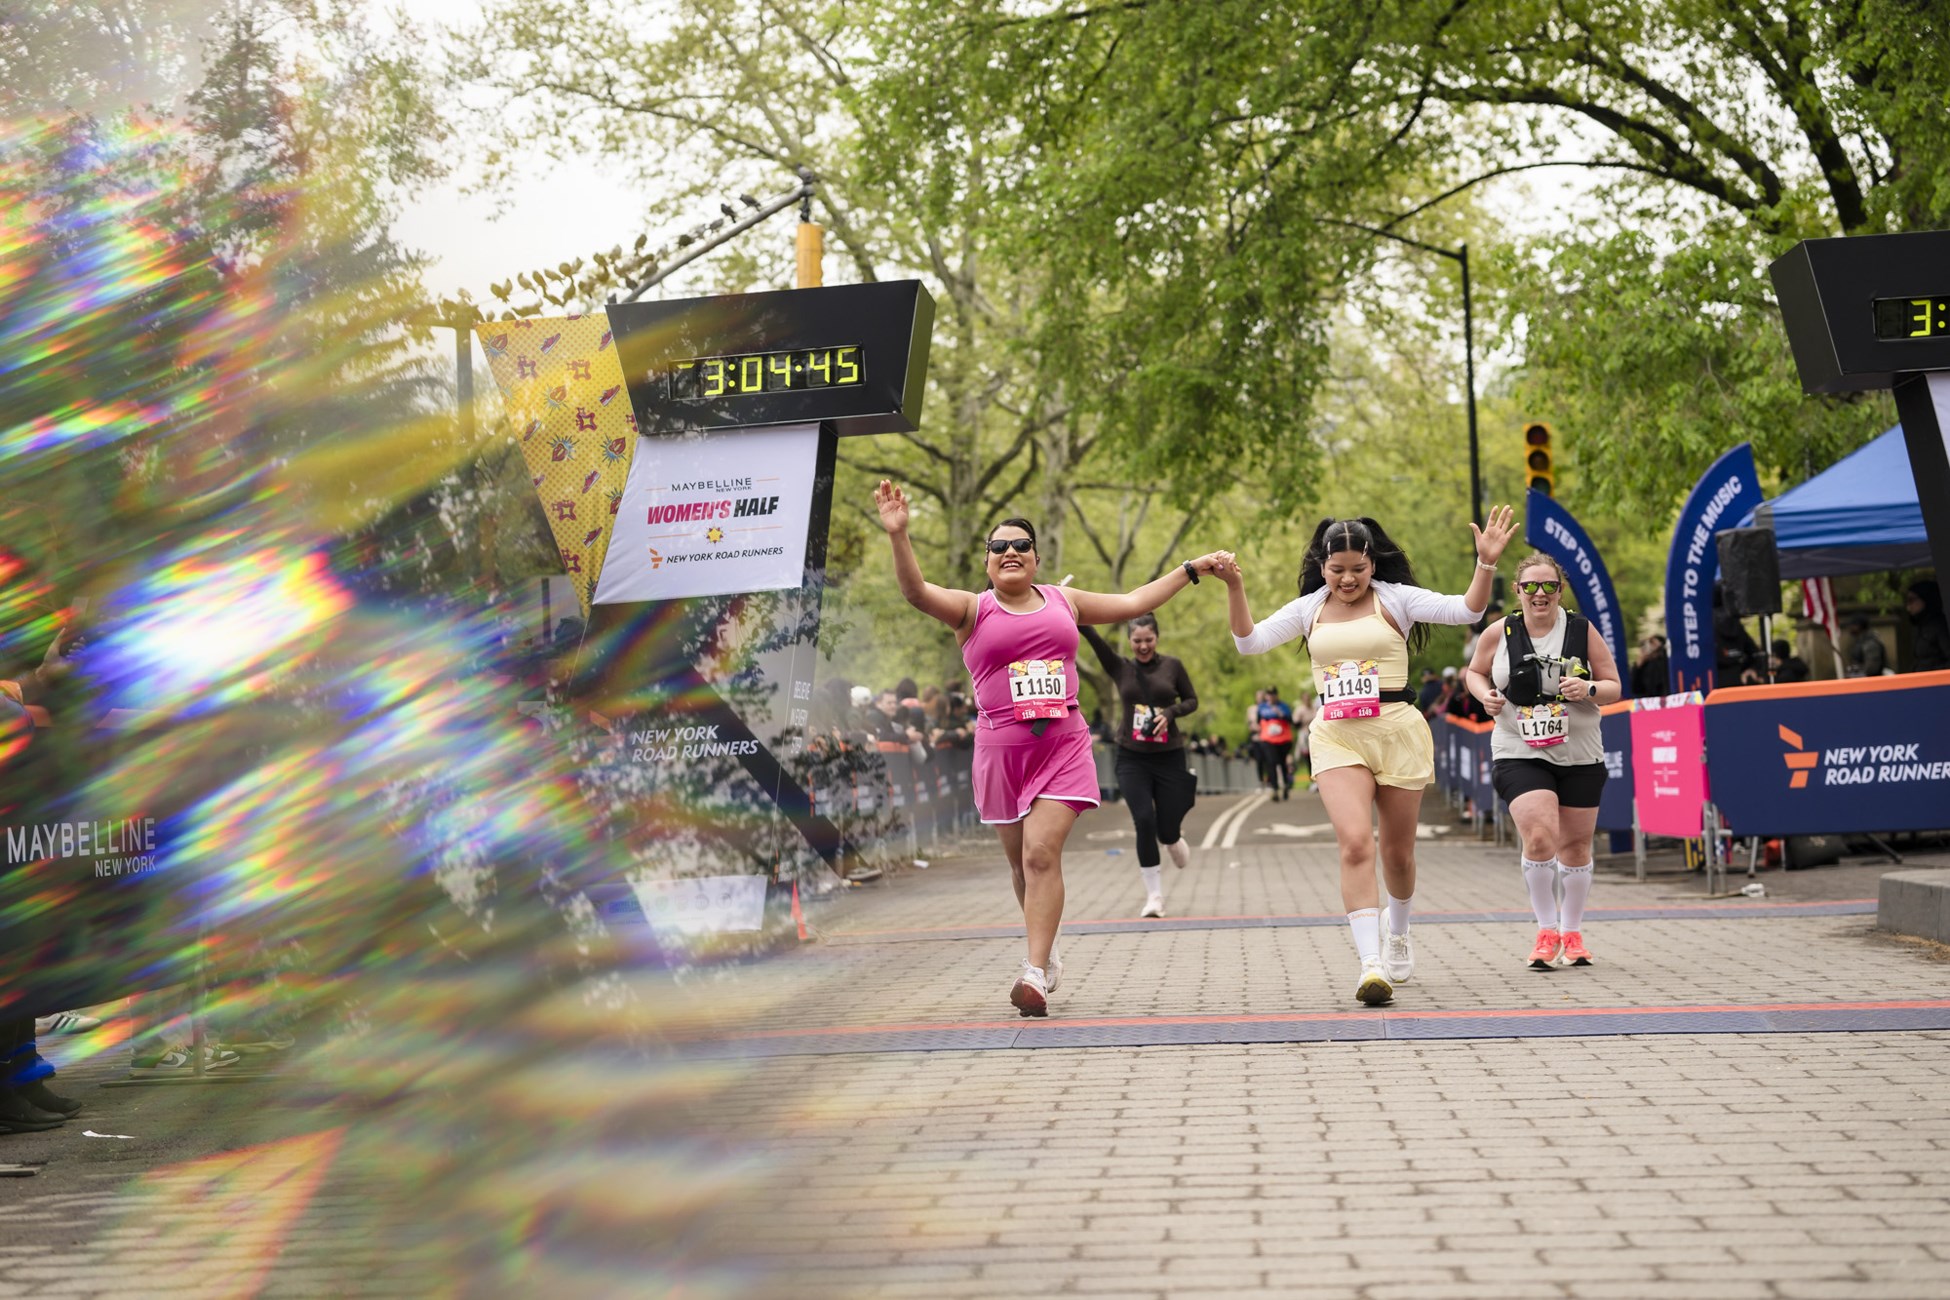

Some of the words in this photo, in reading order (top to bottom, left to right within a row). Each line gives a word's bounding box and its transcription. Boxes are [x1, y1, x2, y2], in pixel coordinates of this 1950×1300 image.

[671, 477, 752, 492] MAYBELLINE
[647, 500, 731, 525] WOMEN'S
[733, 496, 779, 518] HALF
[1701, 475, 1743, 530] MUSIC
[666, 555, 688, 564] NEW
[689, 552, 713, 563] YORK
[715, 550, 740, 560] ROAD
[741, 546, 784, 558] RUNNERS
[1687, 523, 1711, 565] THE
[1544, 516, 1578, 551] STEP
[1575, 546, 1592, 575] TO
[1587, 572, 1608, 613] THE
[1683, 568, 1699, 597] TO
[1684, 602, 1700, 659] STEP
[1027, 677, 1061, 695] 1150
[1327, 684, 1334, 698] L
[1338, 677, 1372, 697] 1149
[1330, 710, 1344, 719] 1149
[1358, 708, 1373, 717] 1149
[632, 729, 671, 745] NEW
[674, 724, 719, 742] YORK
[1521, 722, 1529, 736] L
[1532, 719, 1563, 737] 1764
[632, 747, 678, 763] ROAD
[681, 739, 759, 760] RUNNERS
[1824, 746, 1867, 766] NEW
[1869, 743, 1919, 763] YORK
[1825, 766, 1875, 786] ROAD
[7, 817, 156, 864] MAYBELLINE
[95, 858, 123, 878] NEW
[125, 855, 156, 874] YORK
